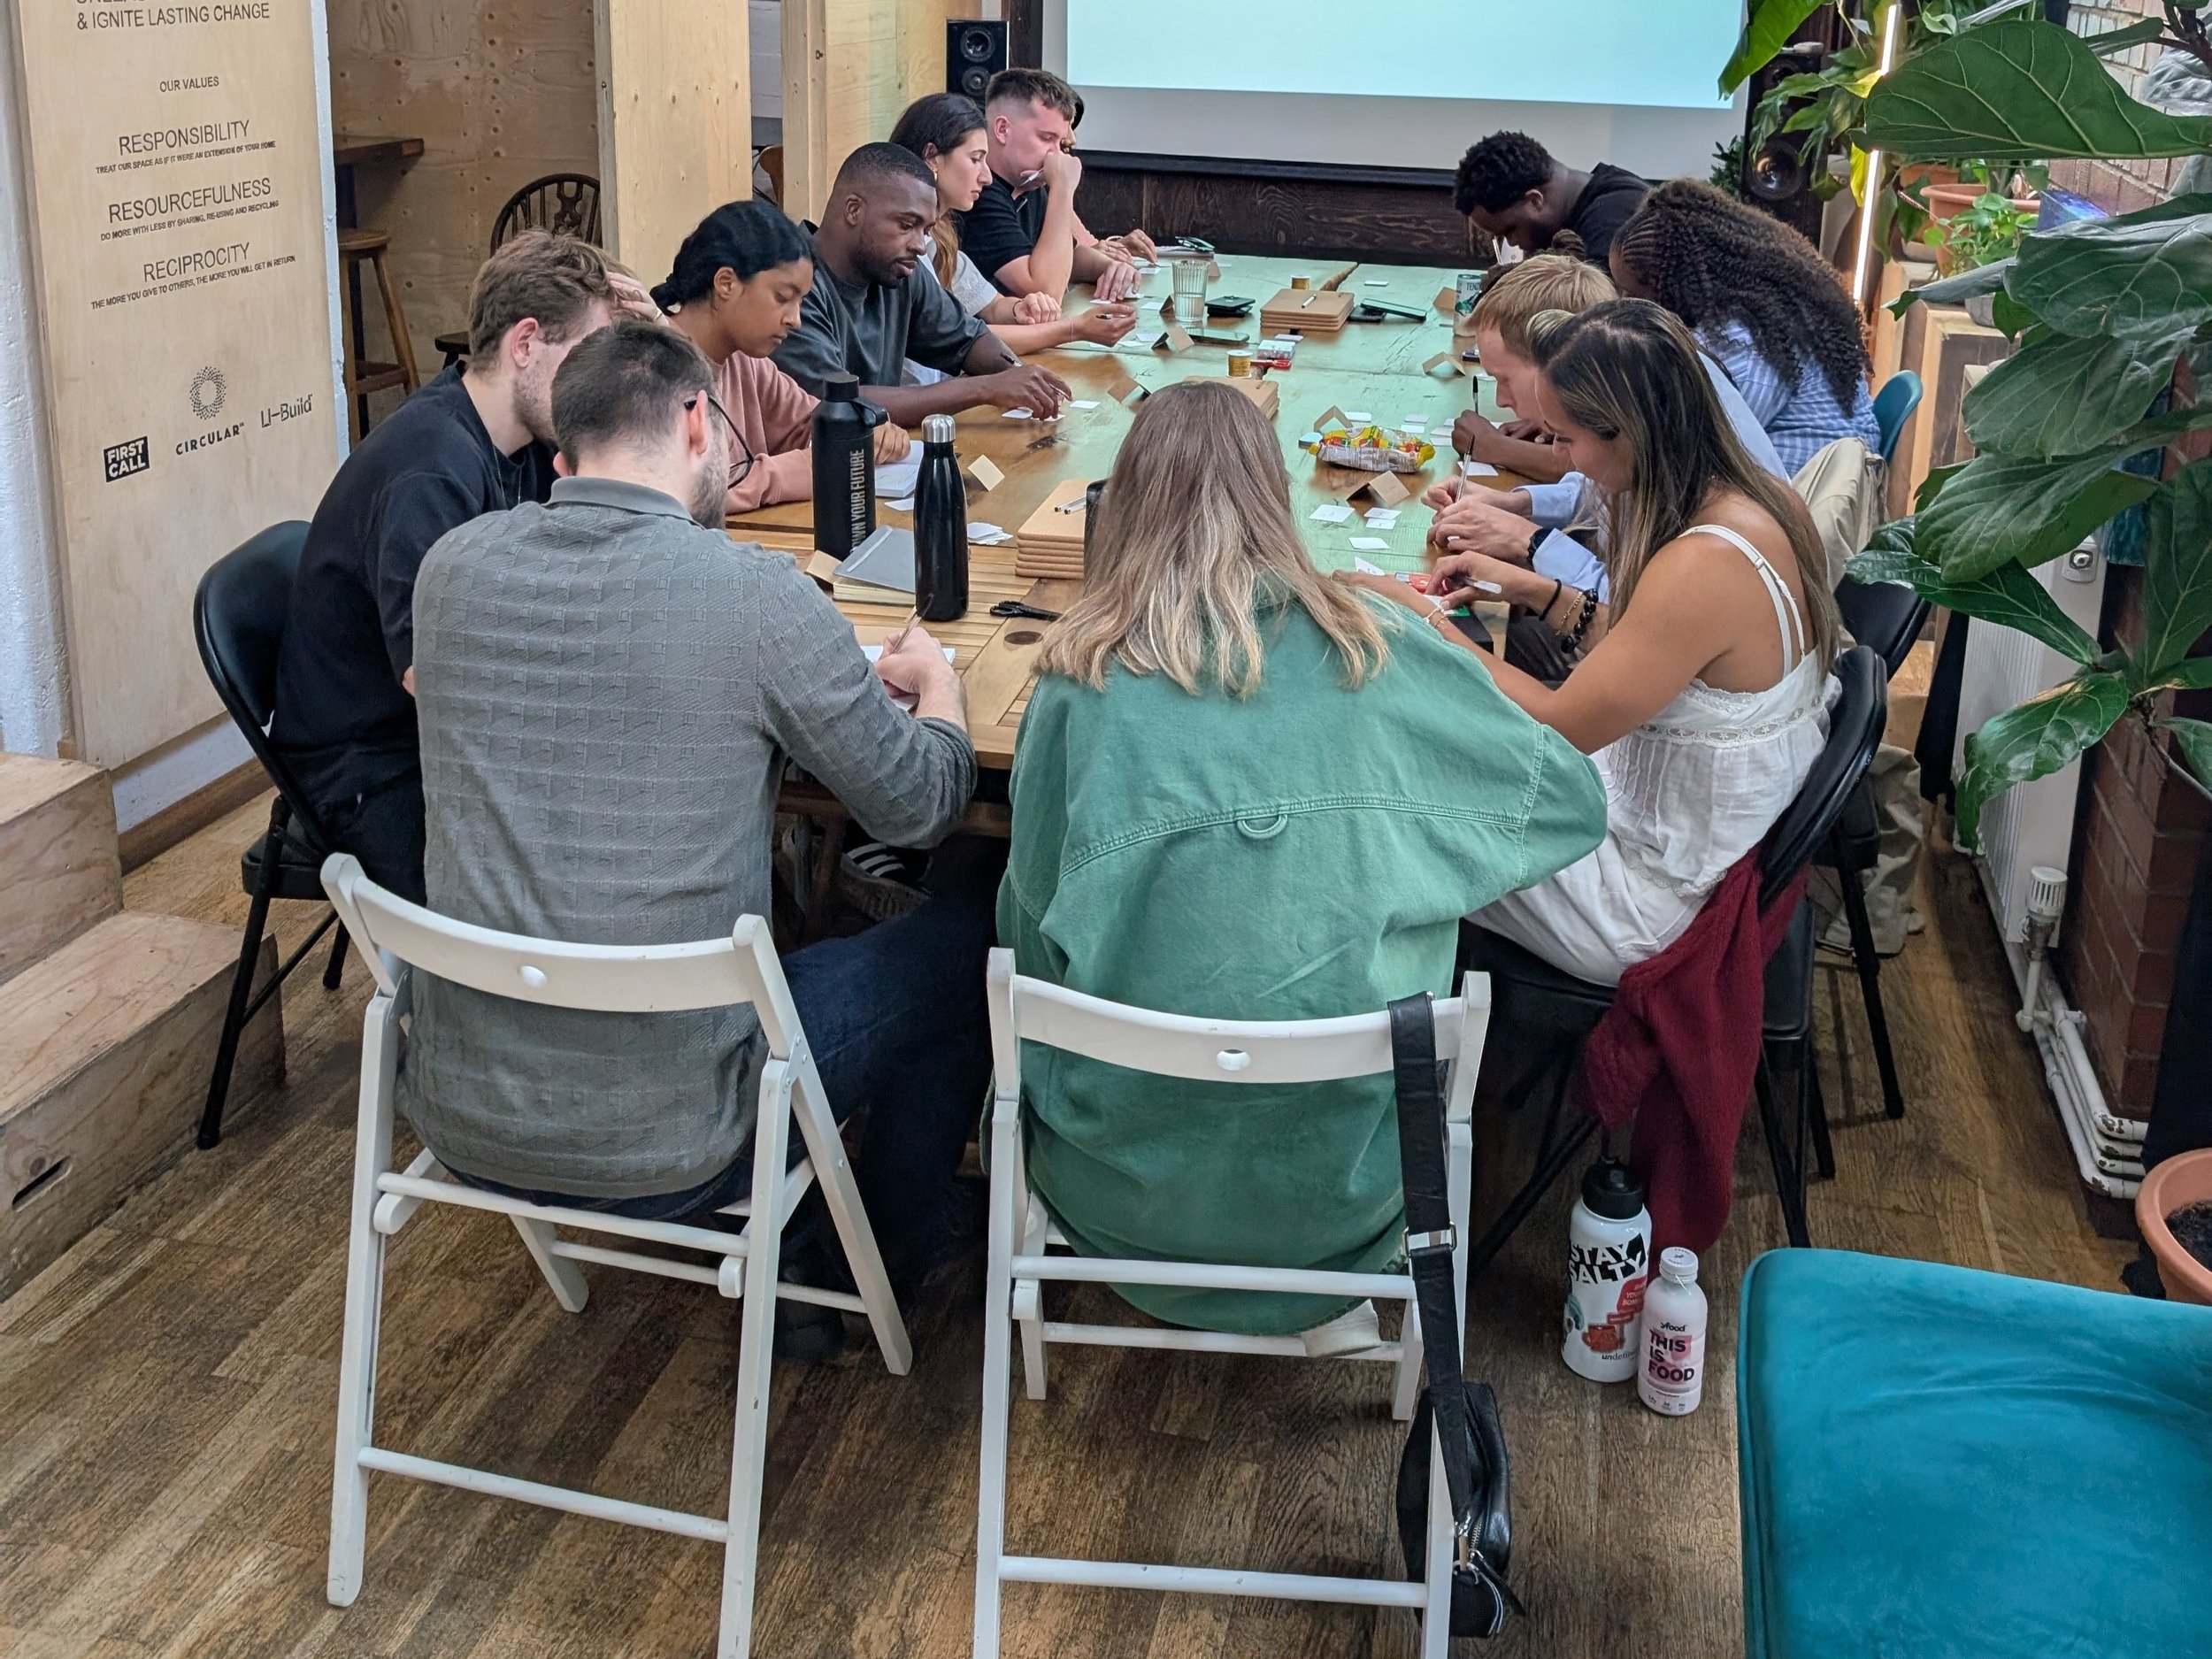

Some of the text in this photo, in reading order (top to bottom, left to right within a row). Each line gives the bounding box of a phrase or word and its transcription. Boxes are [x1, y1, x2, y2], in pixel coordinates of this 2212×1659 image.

[77, 3, 271, 30] & IGNITE LASTING CHANGE
[159, 76, 219, 92] OUR VALUES
[119, 119, 250, 156] RESPONSIBILITY
[96, 164, 116, 173] TREAT
[118, 162, 132, 171] OUR
[133, 159, 153, 169] SPACE
[177, 153, 194, 162] WERE
[204, 146, 235, 158] EXTENSION
[244, 142, 260, 151] YOUR
[109, 177, 271, 223] RESOURCEFULNESS
[112, 228, 132, 239] MORE
[133, 225, 149, 235] WITH
[150, 222, 166, 231] LESS
[167, 219, 176, 228] BY
[177, 214, 206, 227] SHARING,
[206, 209, 234, 220] RE-USING
[248, 200, 279, 212] RECYCLING
[143, 242, 250, 282] RECIPROCITY
[91, 299, 104, 310] THE
[106, 295, 126, 305] MORE
[127, 291, 142, 301] YOU
[142, 288, 157, 297] GIVE
[158, 285, 167, 294] TO
[168, 279, 196, 291] OTHERS,
[196, 275, 208, 285] THE
[209, 271, 227, 281] MORE
[227, 268, 240, 277] YOU
[241, 265, 253, 273] WILL
[254, 262, 265, 271] GET
[273, 255, 296, 266] RETURN
[107, 440, 145, 464] FIRST
[175, 424, 241, 455] CIRCULAR
[108, 455, 146, 478] CALL
[849, 448, 864, 490] FUTURE
[850, 490, 865, 521] YOUR
[1568, 1249, 1643, 1284] SALTY
[1570, 1242, 1631, 1266] STAY
[1649, 1328, 1686, 1352] THIS
[1649, 1345, 1664, 1363] IS
[1648, 1359, 1695, 1381] FOOD
